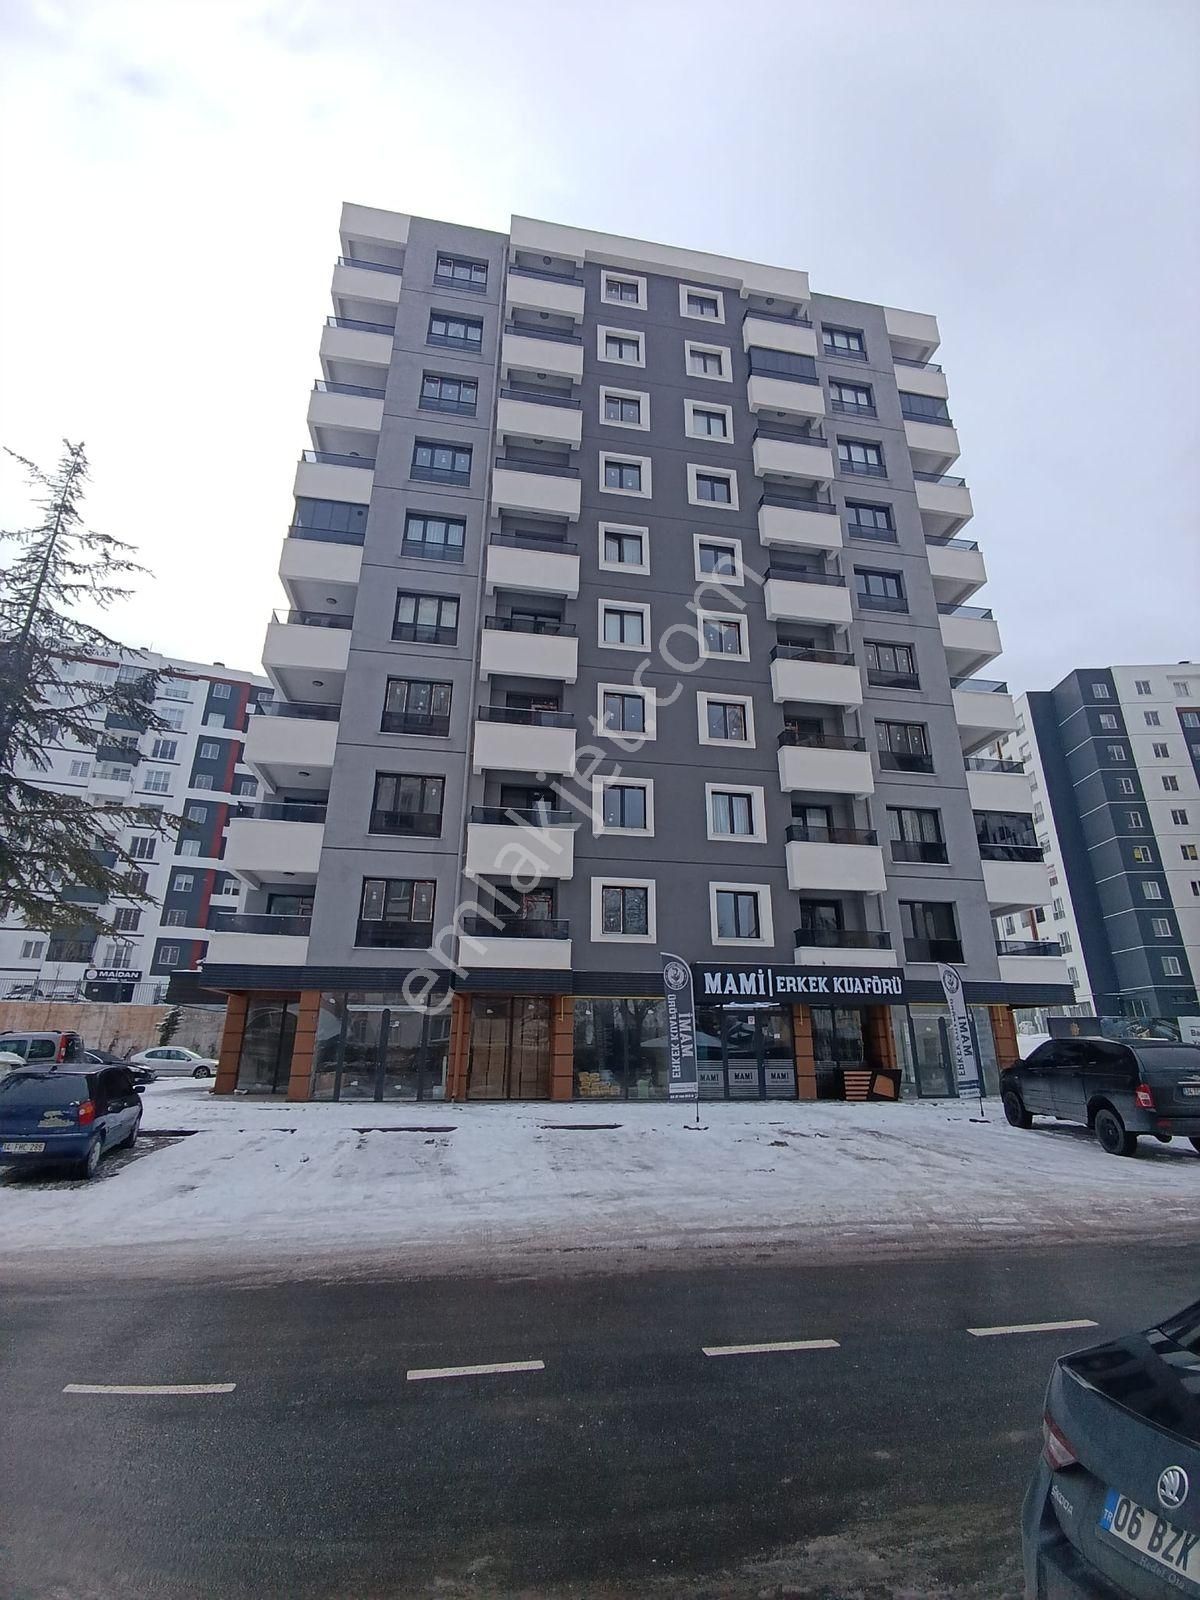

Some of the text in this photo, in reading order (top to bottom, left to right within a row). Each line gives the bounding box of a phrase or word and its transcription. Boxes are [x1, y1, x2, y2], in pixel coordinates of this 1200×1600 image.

[704, 969, 766, 995] MAMİ
[776, 976, 830, 993] ERKEK
[832, 976, 902, 995] KUAFÖRÜ
[1114, 1498, 1200, 1571] 06 BZK
